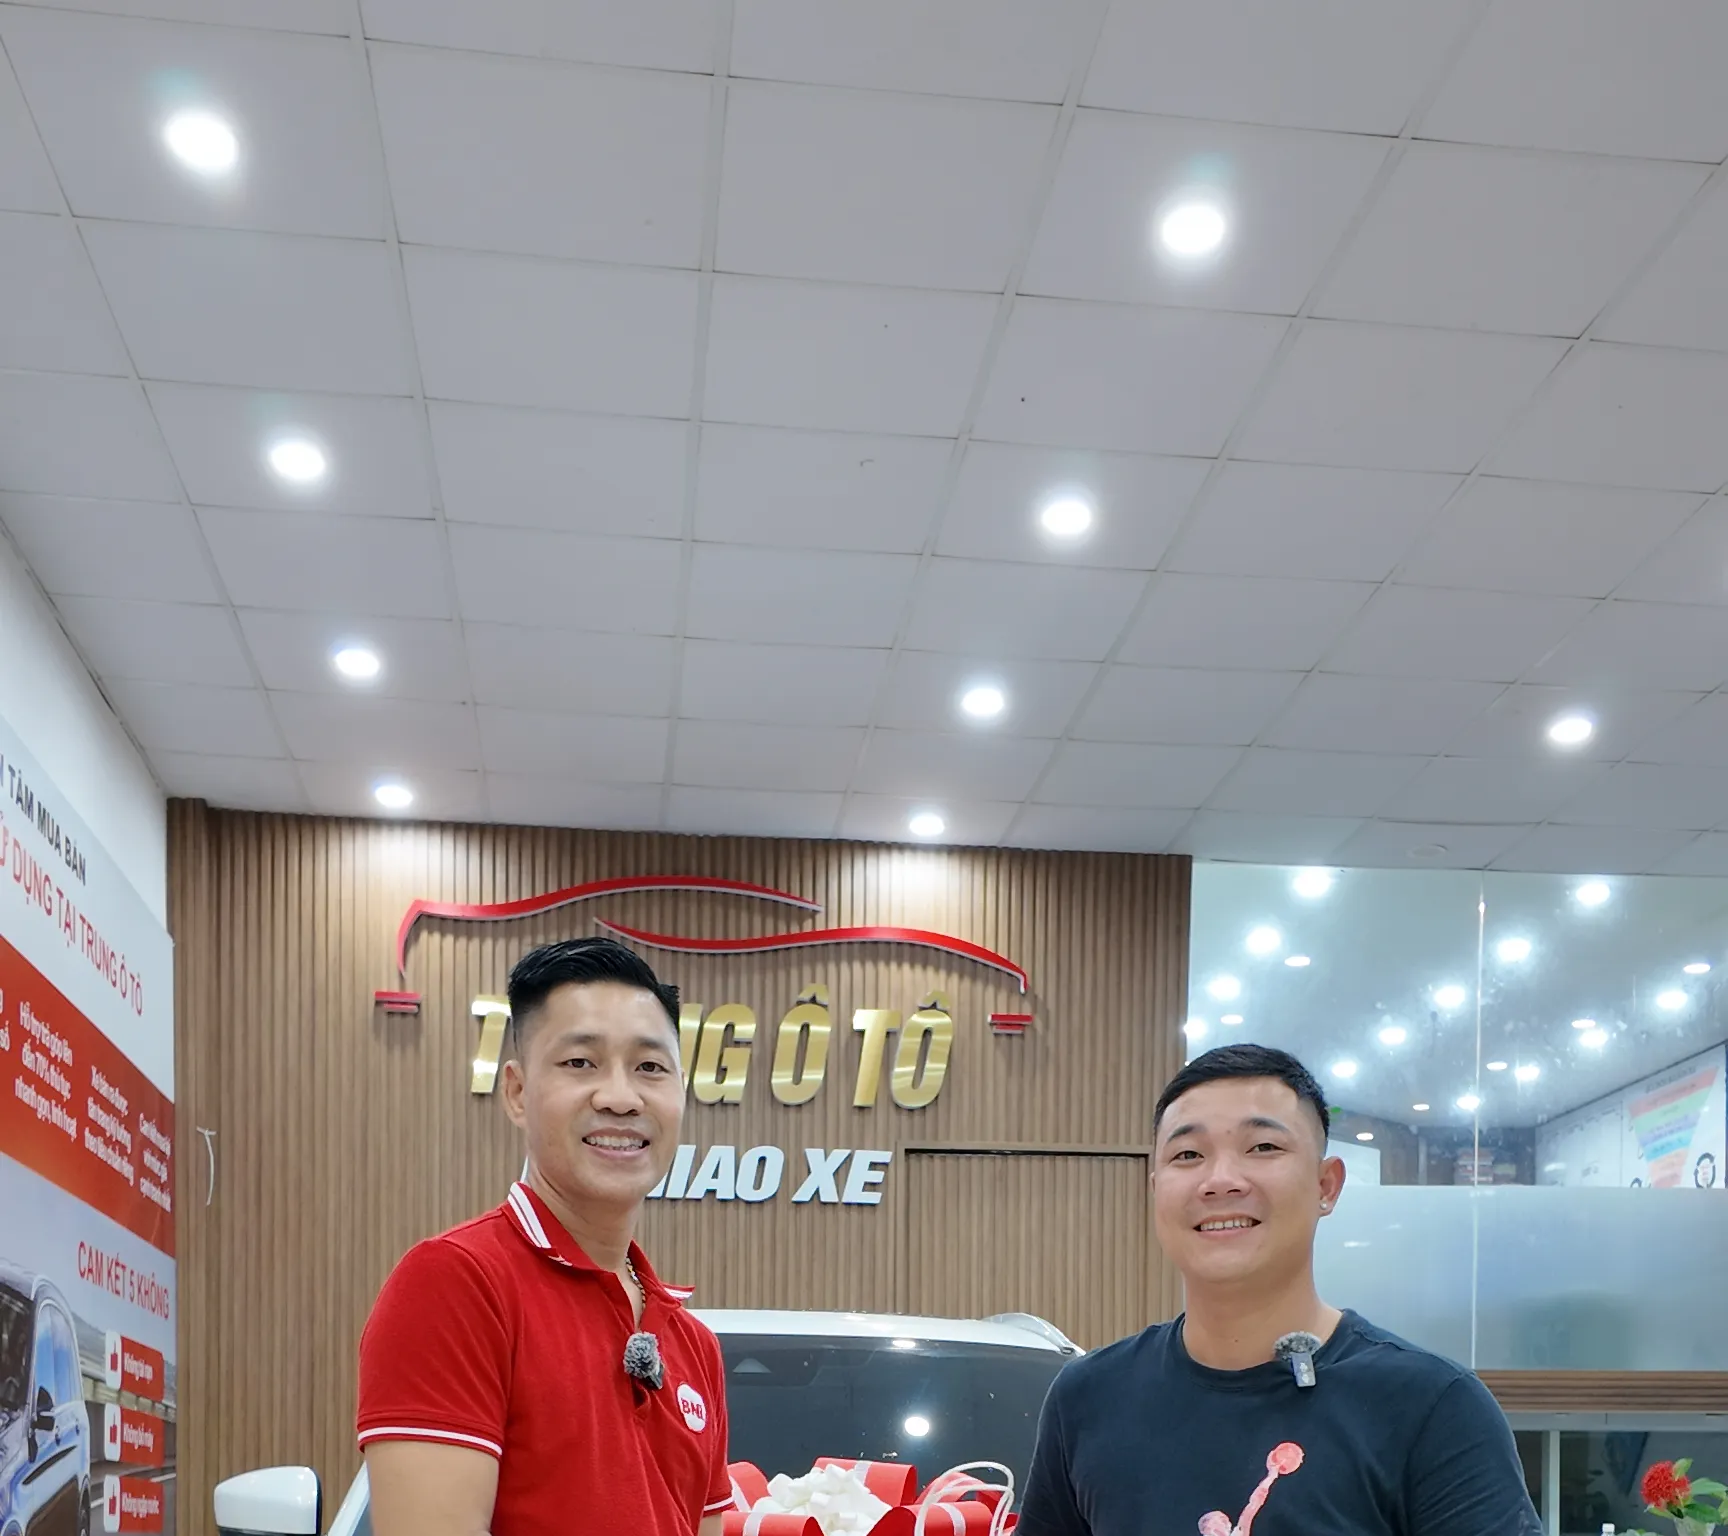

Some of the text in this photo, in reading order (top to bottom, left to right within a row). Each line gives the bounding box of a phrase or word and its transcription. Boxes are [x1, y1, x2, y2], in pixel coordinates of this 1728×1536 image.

[37, 801, 62, 857] MUA
[12, 837, 52, 916] DỤNG
[56, 887, 76, 947] TẠI
[79, 913, 117, 987] TRUNG
[119, 954, 128, 999] Ô
[129, 972, 143, 1016] TÔ
[770, 984, 832, 1107] Ô
[853, 989, 955, 1111] TÔ
[646, 1144, 893, 1204] IAO XE
[78, 1240, 169, 1320] CAM KẾT 5 KHÔNG
